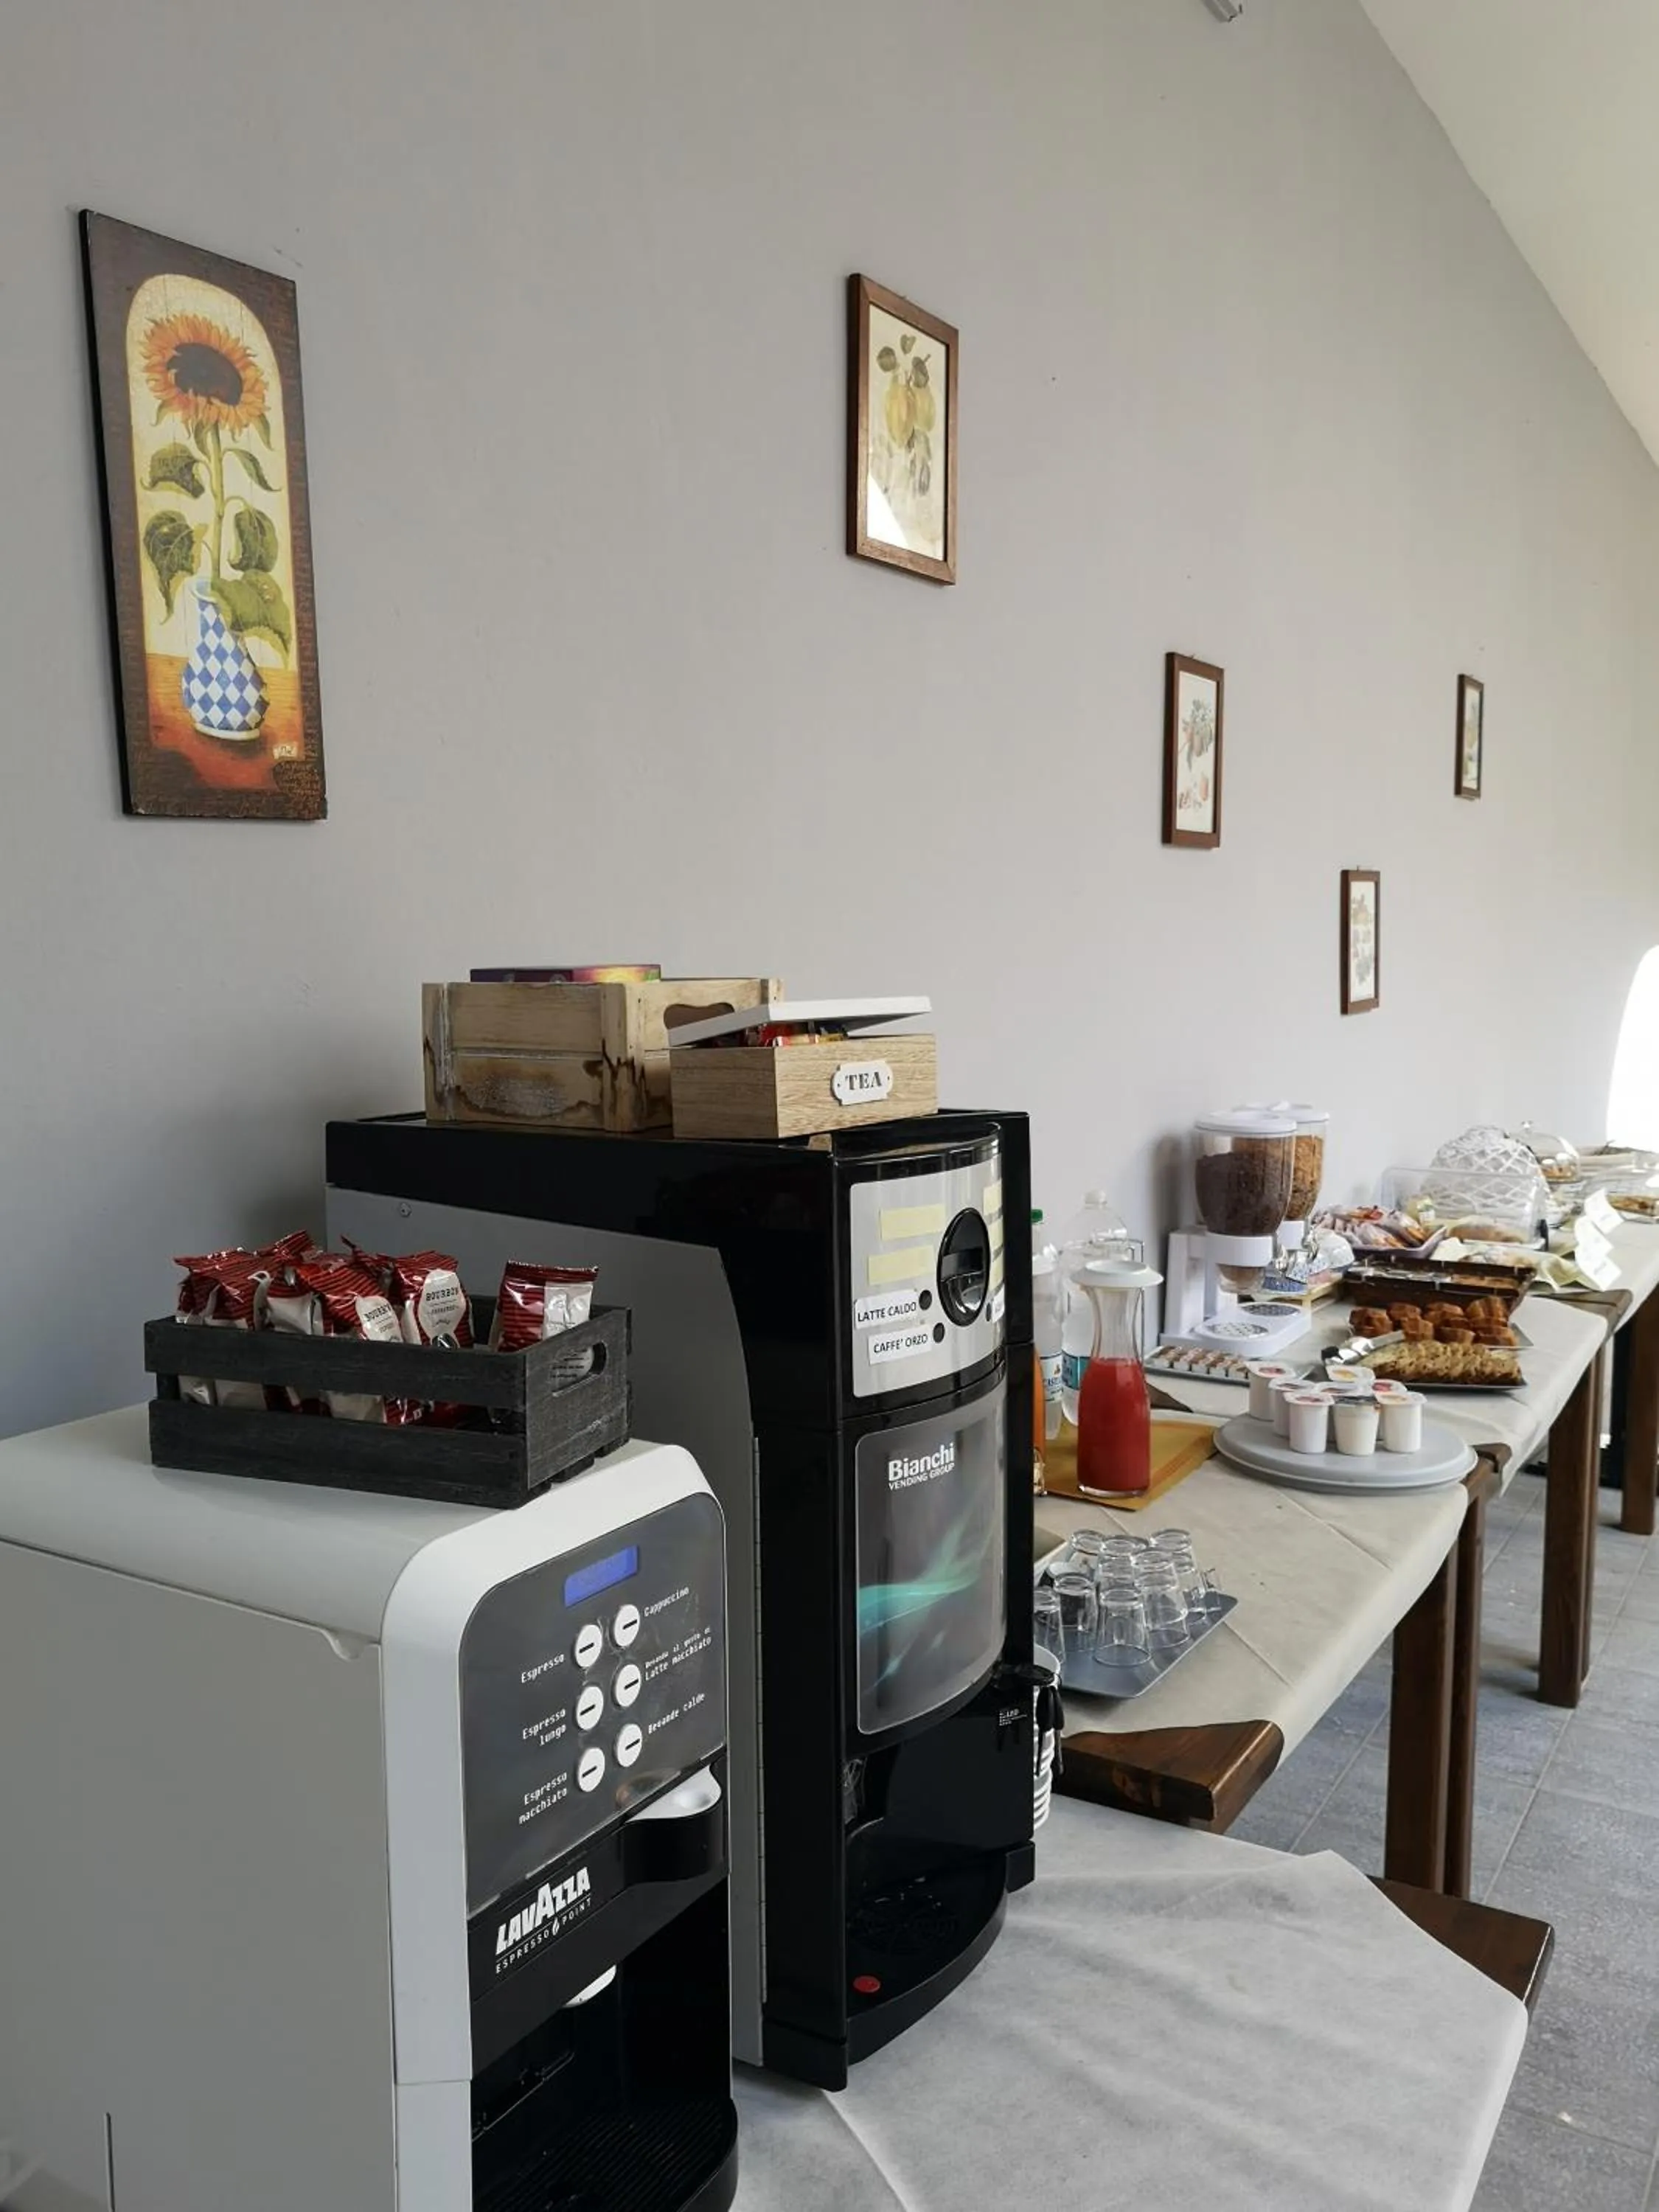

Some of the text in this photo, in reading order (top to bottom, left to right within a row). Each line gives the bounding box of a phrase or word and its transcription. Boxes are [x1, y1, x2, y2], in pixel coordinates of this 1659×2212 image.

[844, 1071, 883, 1091] TEA
[857, 1301, 917, 1323] LATTE CALDO
[873, 1333, 928, 1354] CAFFE' ORZO
[888, 1441, 955, 1481] Bianchi
[888, 1462, 955, 1491] VENDING GROUP
[644, 1586, 689, 1617] Cappuccino
[521, 1654, 565, 1683] Espresso
[645, 1636, 712, 1681] Latte macchiato
[523, 1708, 566, 1739] Espresso
[648, 1693, 706, 1734] Bevande calde
[540, 1724, 566, 1746] lungo
[524, 1772, 567, 1805] Espresso
[518, 1787, 567, 1825] macchiato
[495, 1866, 591, 1955] LAVAZZA
[496, 1897, 591, 1974] ESPRESSO POINT
